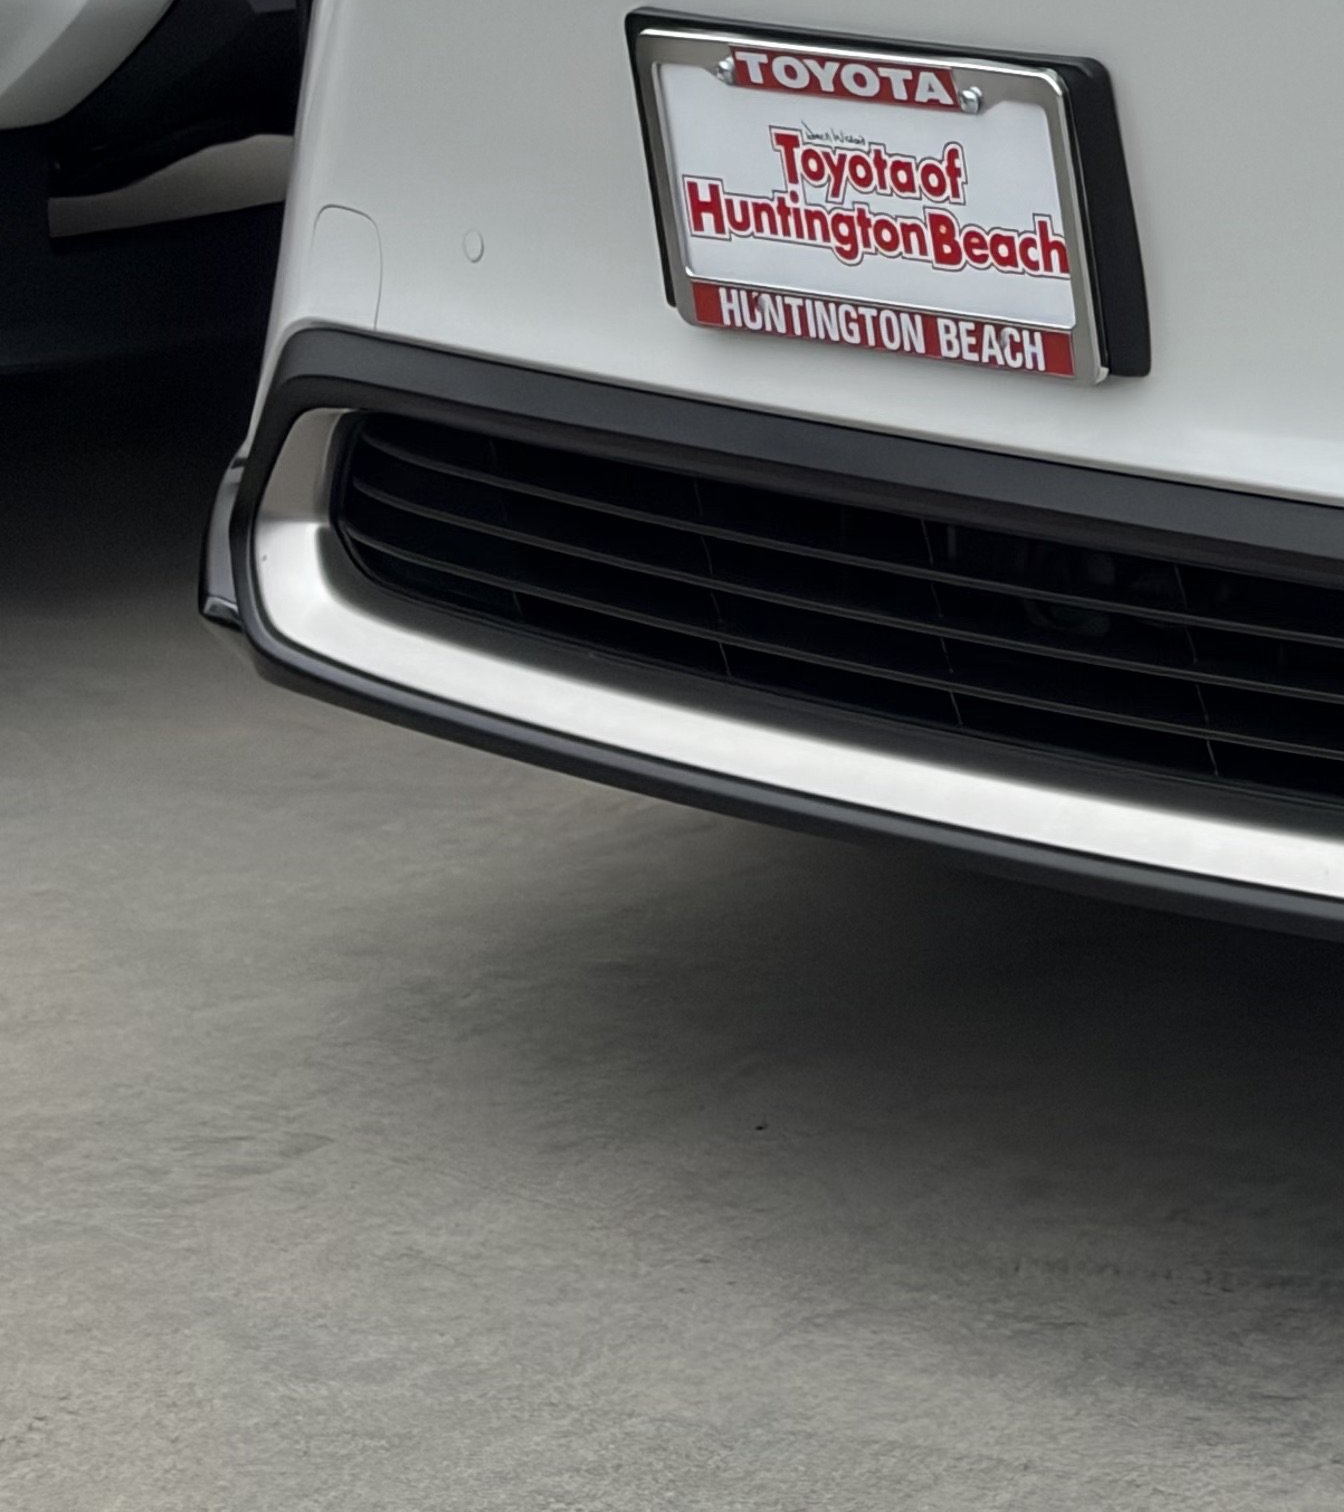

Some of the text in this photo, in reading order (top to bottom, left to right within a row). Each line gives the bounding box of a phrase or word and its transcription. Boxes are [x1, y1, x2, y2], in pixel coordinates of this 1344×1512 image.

[736, 52, 954, 104] TOYOTA
[771, 127, 966, 205] Toyota of
[686, 178, 1070, 275] Huntington Beach
[720, 288, 1047, 372] HUNTINGTON BEACH
